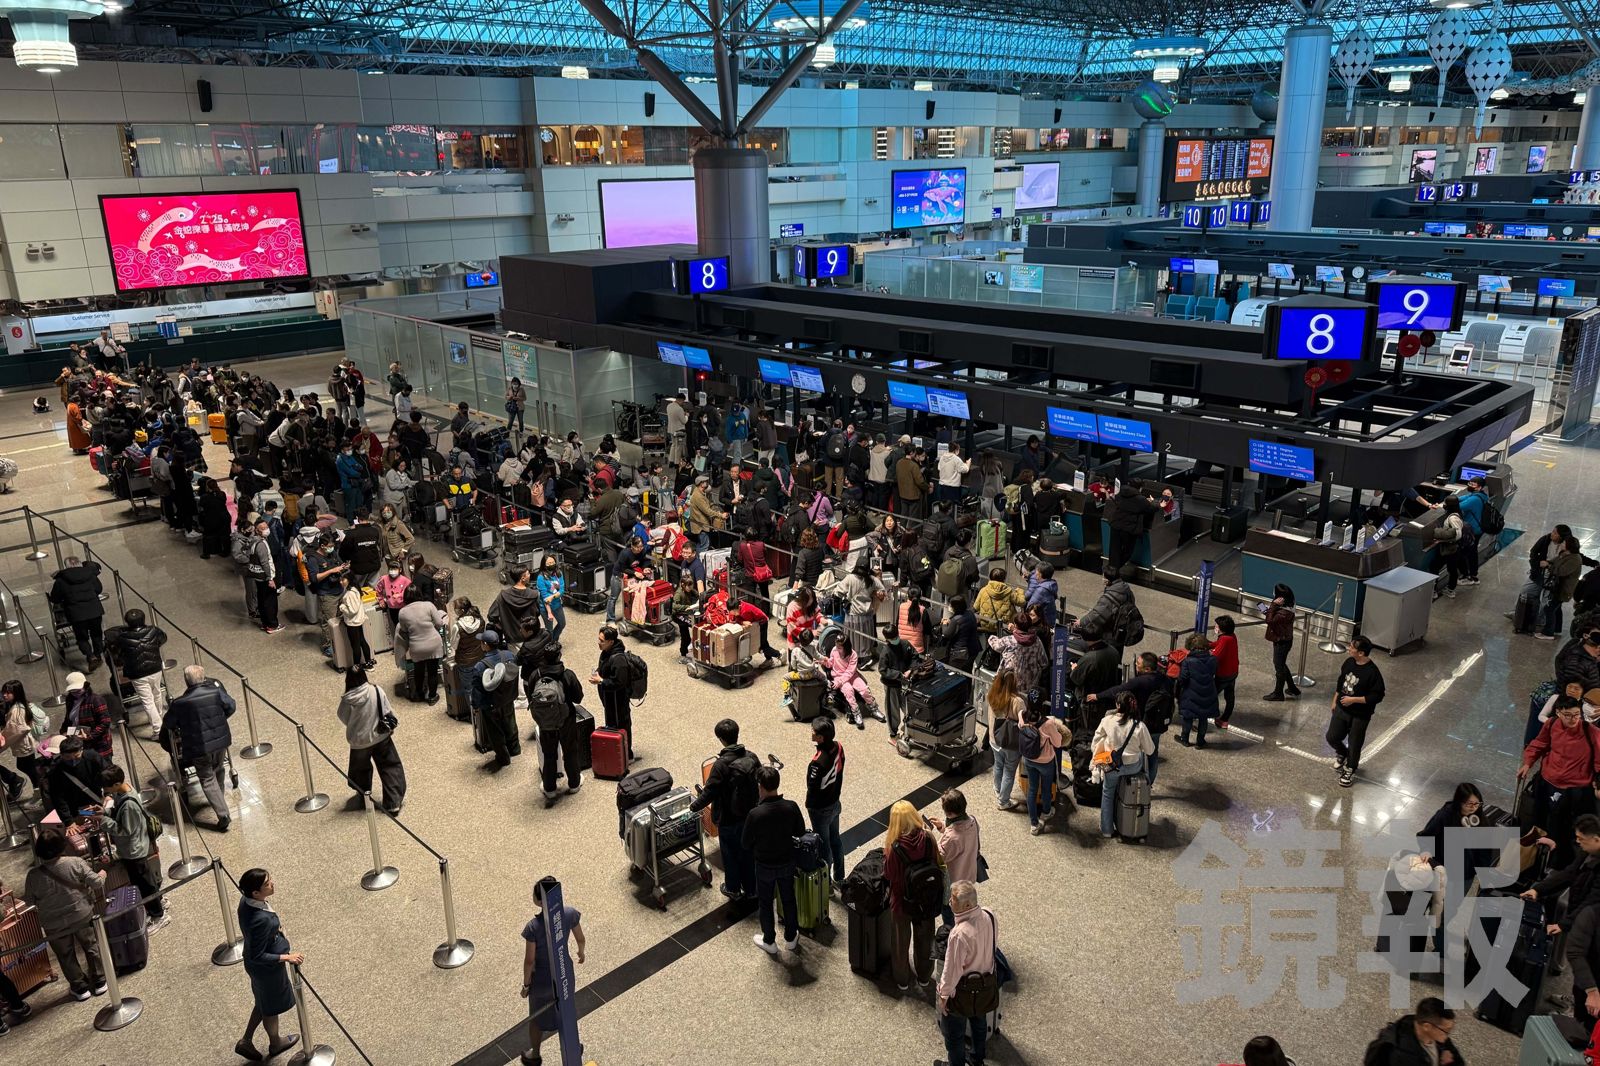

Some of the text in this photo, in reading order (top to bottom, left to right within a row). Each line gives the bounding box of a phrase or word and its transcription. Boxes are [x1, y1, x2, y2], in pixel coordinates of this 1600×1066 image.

[1572, 172, 1584, 182] 14
[1422, 187, 1436, 200] 12
[1451, 184, 1464, 197] 13
[1187, 208, 1200, 226] 10
[1212, 207, 1225, 225] 10
[1234, 203, 1247, 220] 11
[1260, 204, 1270, 220] 11
[797, 249, 803, 273] 9
[827, 249, 838, 274] 9
[702, 262, 715, 289] 8
[1403, 289, 1429, 325] 9
[1306, 313, 1335, 354] 8
[832, 384, 837, 392] 6
[883, 393, 888, 401] 5
[978, 410, 983, 418] 4
[1040, 420, 1046, 429] 3
[1165, 442, 1171, 451] 2
[1329, 471, 1334, 481] 1
[558, 945, 569, 1000] Economy Class
